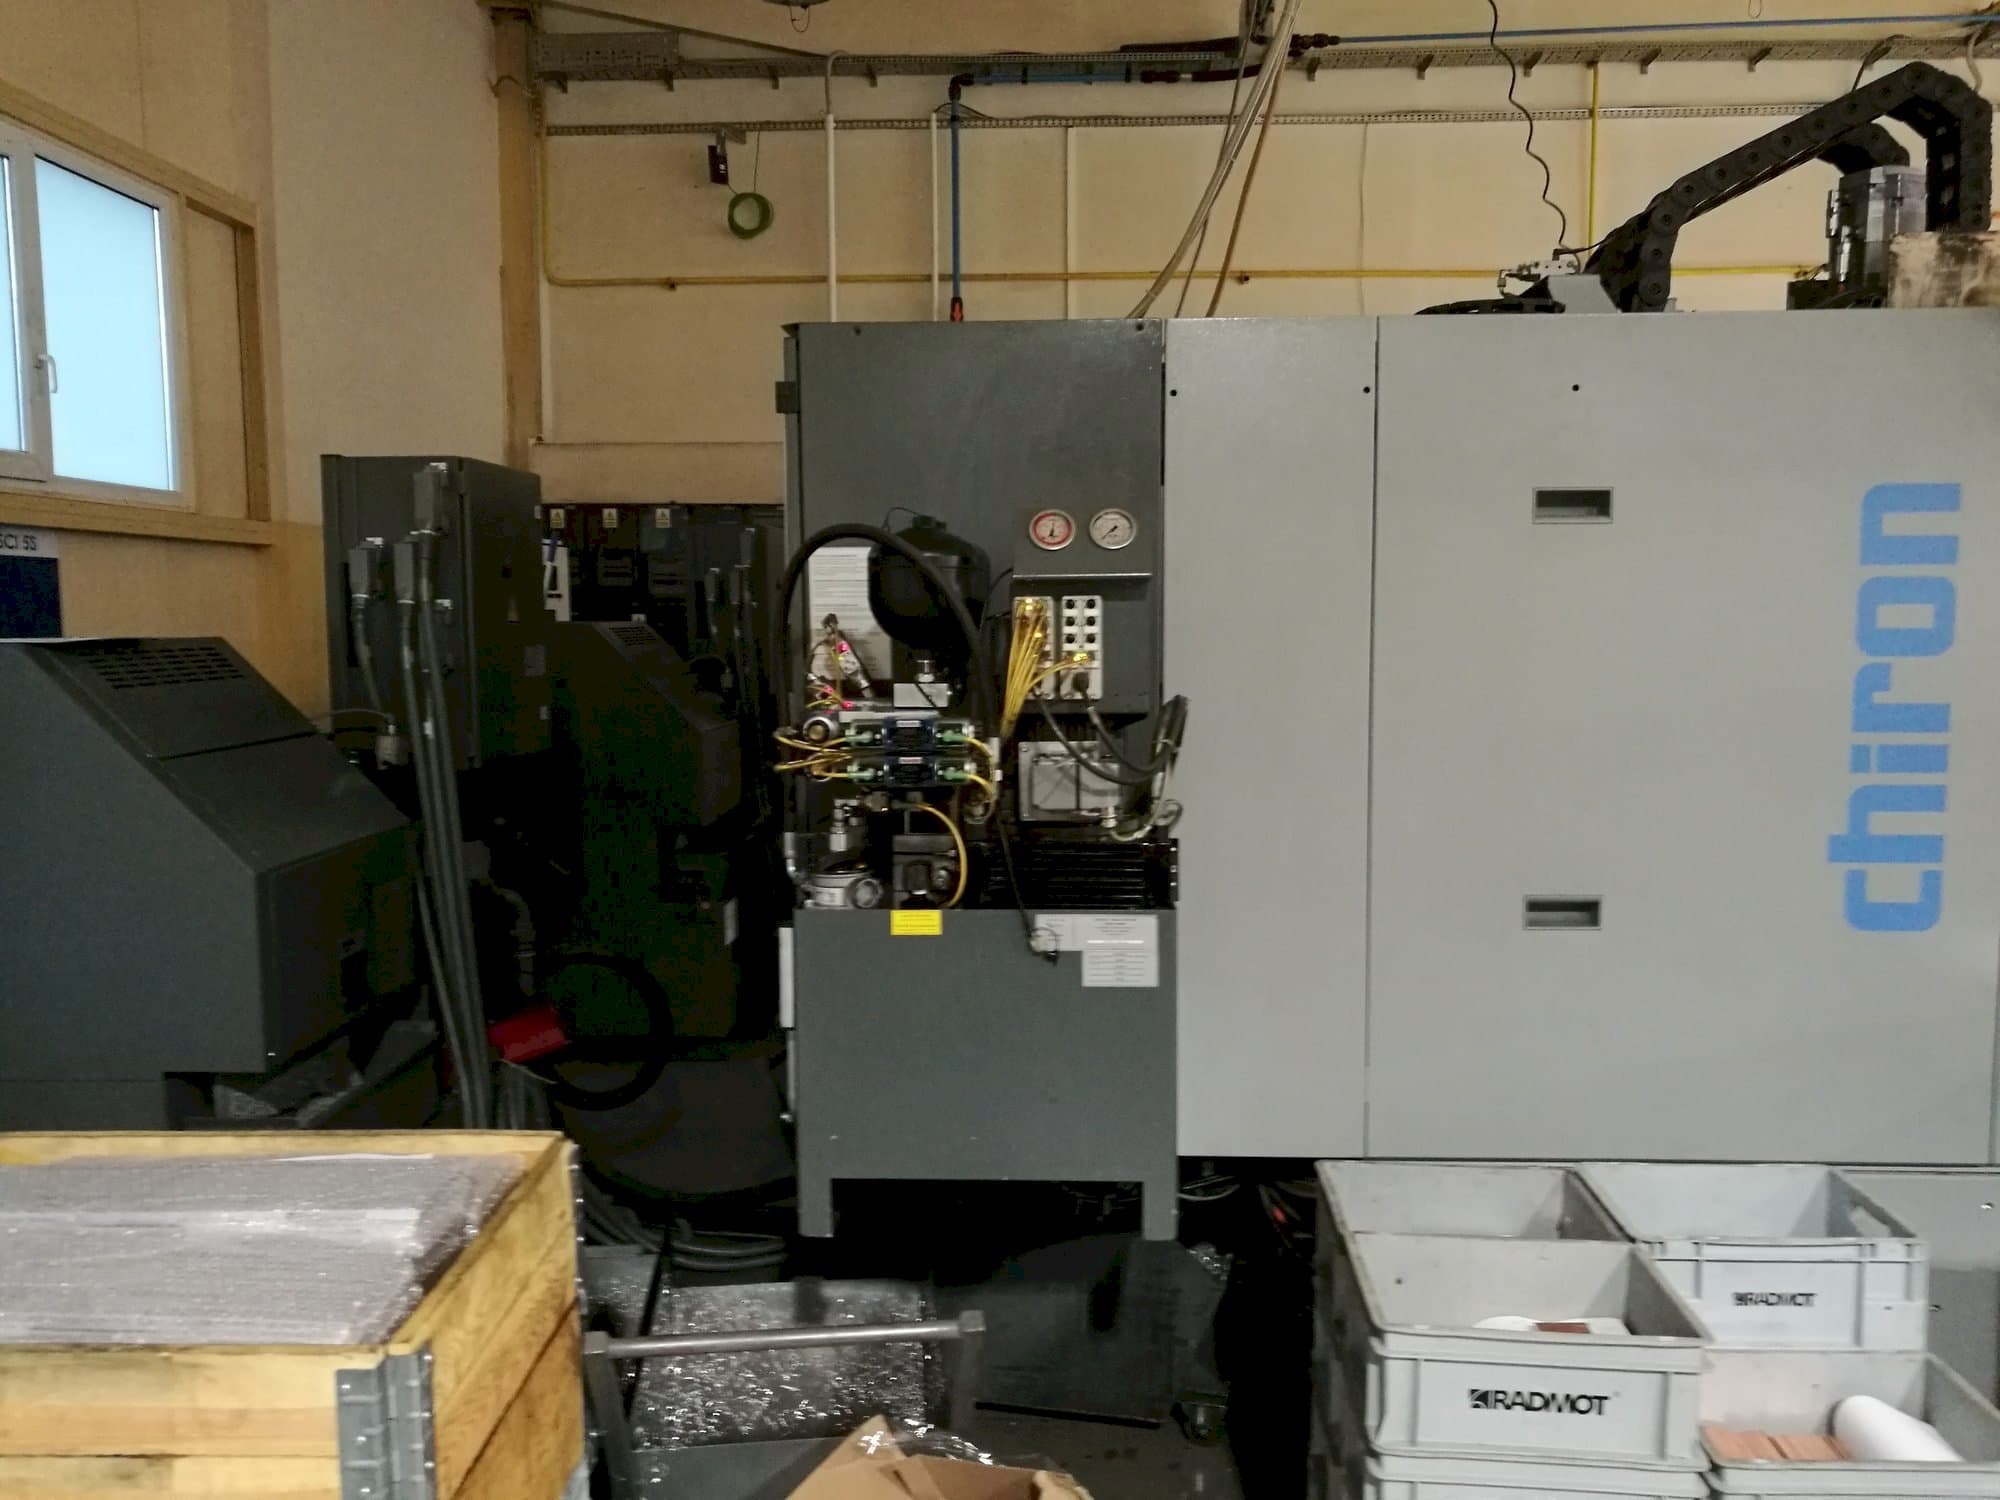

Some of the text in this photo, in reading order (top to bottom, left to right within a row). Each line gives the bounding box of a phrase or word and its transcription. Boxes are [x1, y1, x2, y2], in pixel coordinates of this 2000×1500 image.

[1827, 482, 1961, 932] chiron
[1743, 1292, 1817, 1307] RADMOT
[1493, 1389, 1610, 1415] RADMOT
